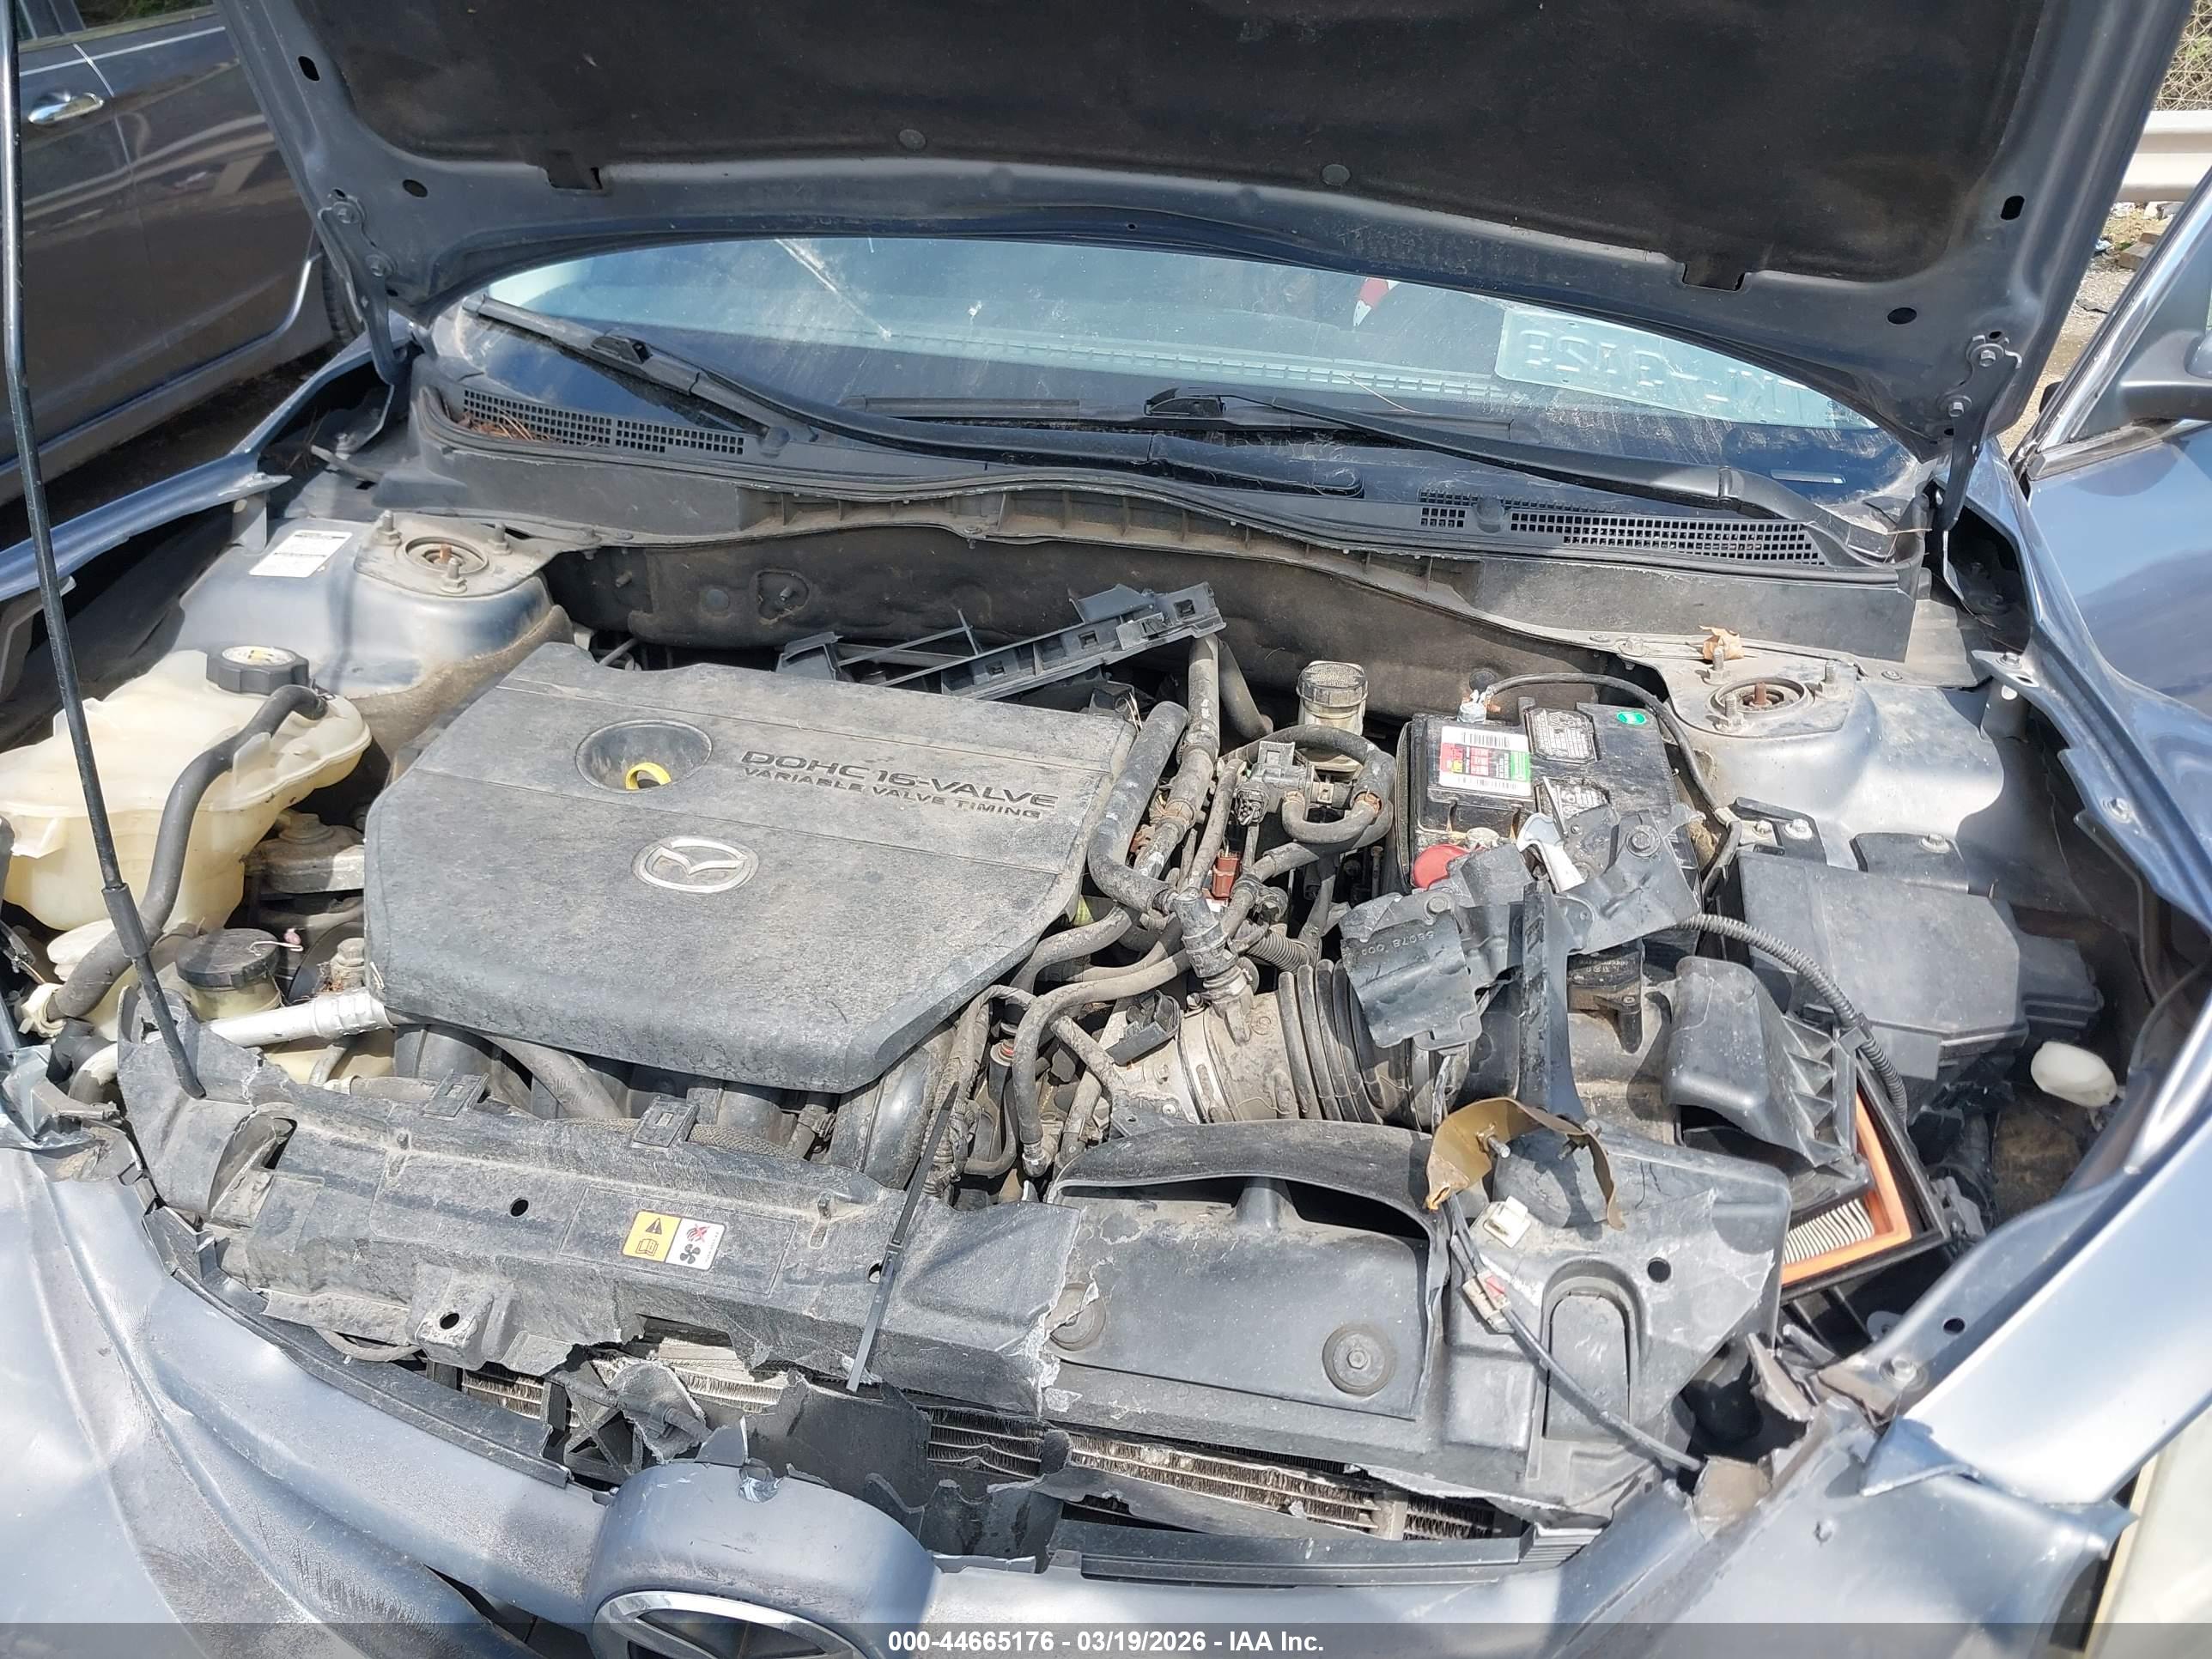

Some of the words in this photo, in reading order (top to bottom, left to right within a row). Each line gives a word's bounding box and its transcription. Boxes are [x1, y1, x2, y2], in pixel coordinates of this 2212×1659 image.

[741, 750, 869, 778] DOHC
[877, 769, 1059, 808] 16-VALVE
[744, 767, 865, 792] VARIABLE
[872, 786, 946, 805] VALVE
[954, 799, 1042, 819] TIMING
